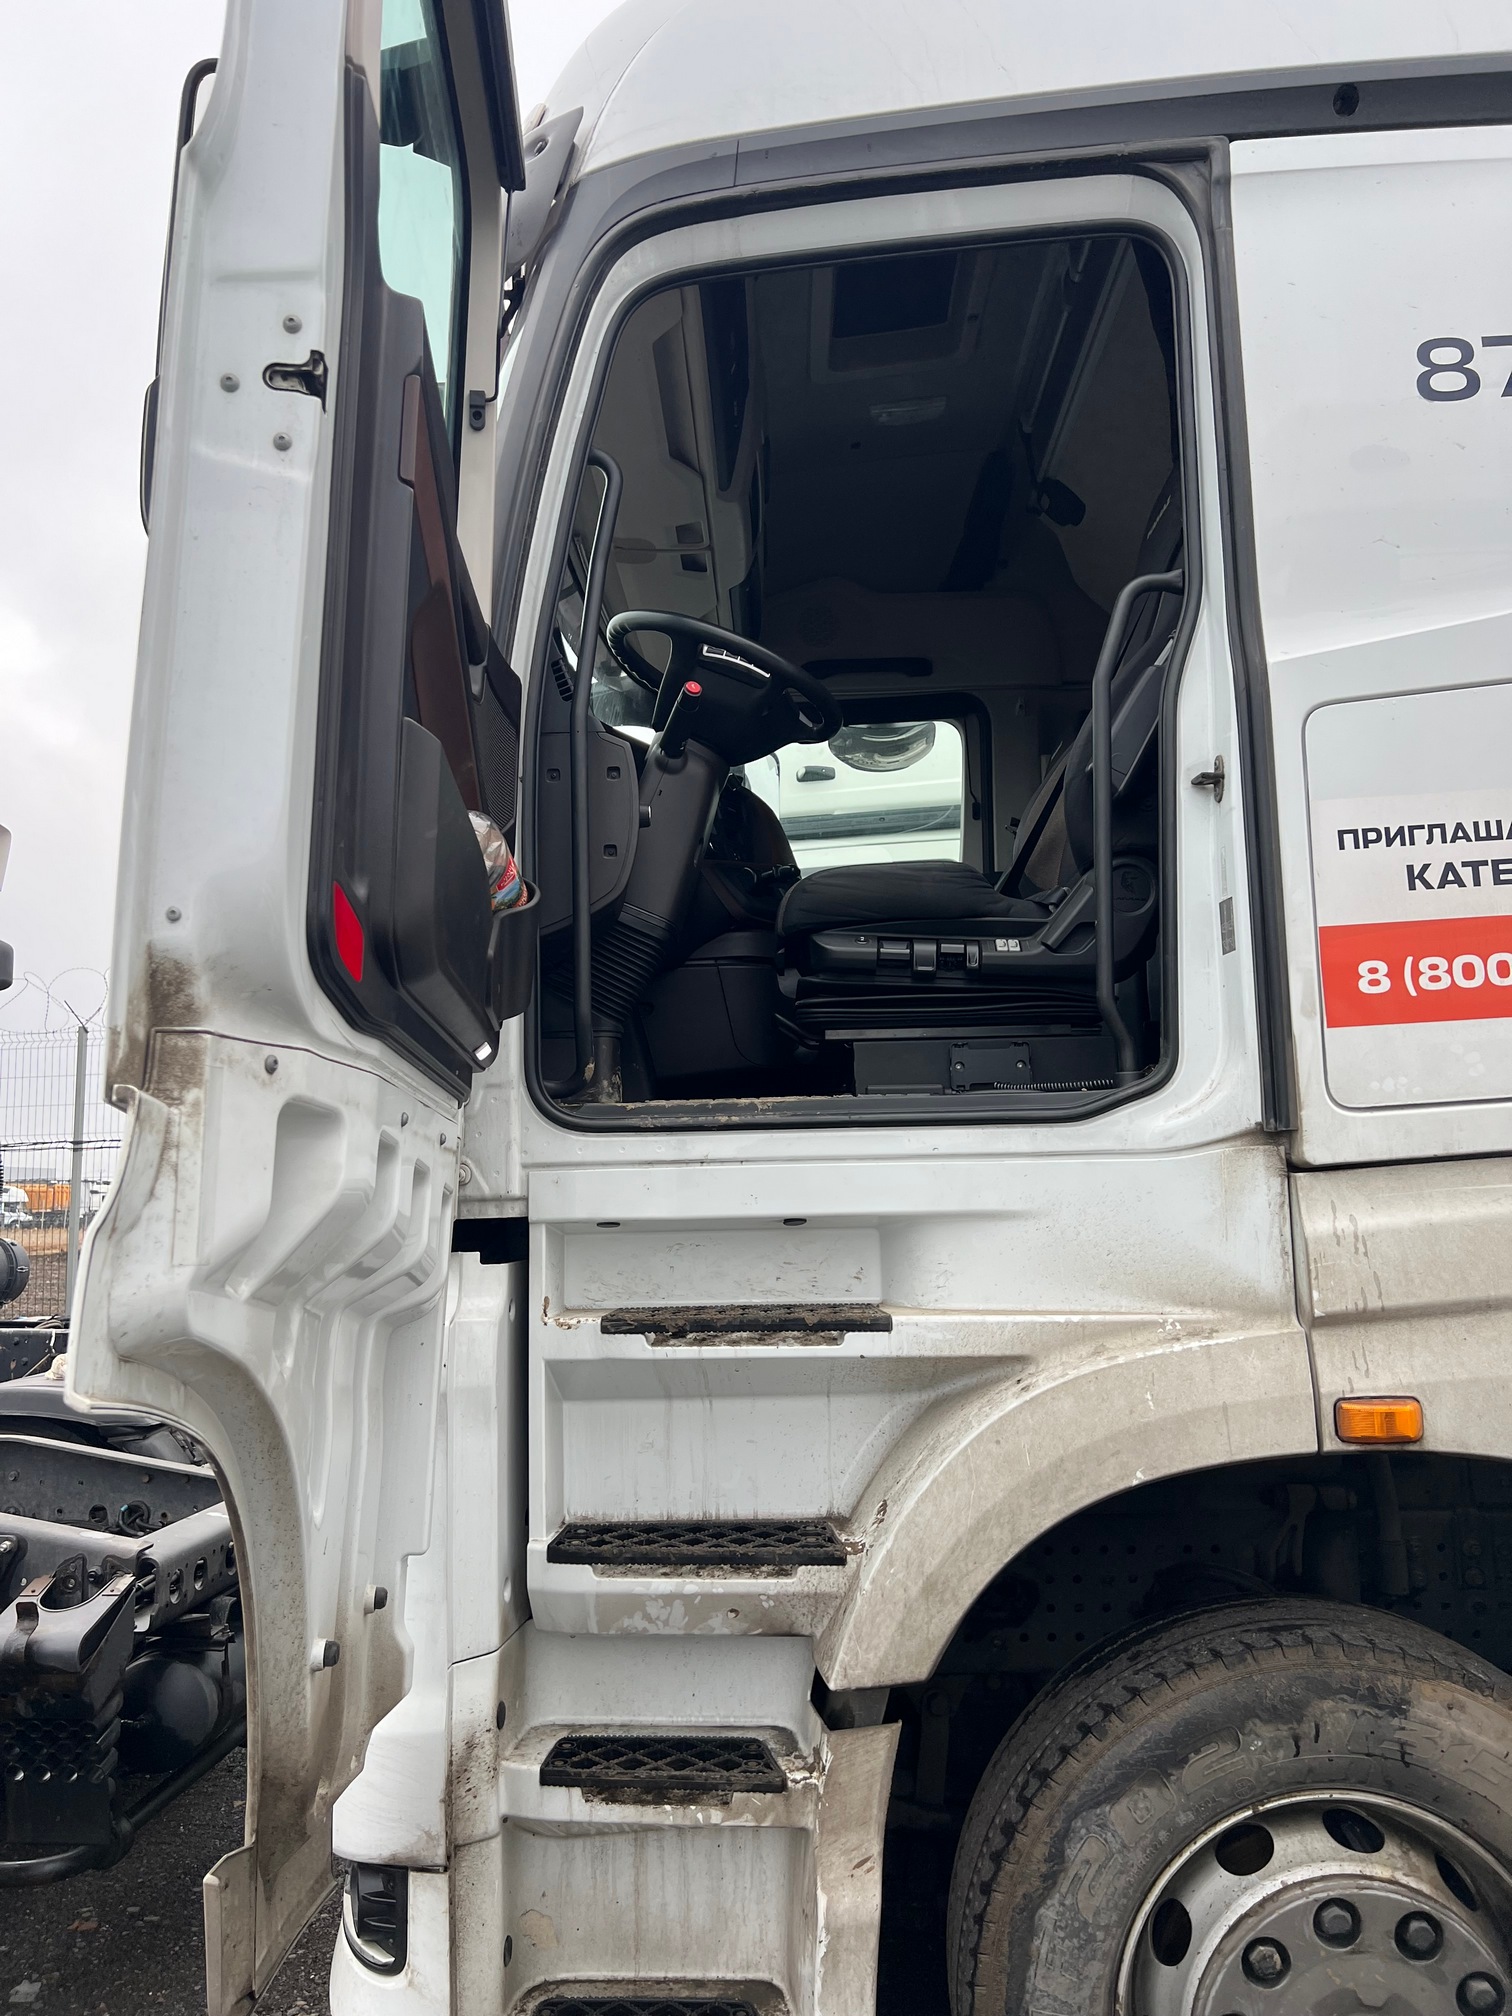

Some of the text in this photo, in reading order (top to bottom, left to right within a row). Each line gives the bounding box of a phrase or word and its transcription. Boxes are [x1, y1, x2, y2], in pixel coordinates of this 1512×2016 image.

[1337, 819, 1512, 851] ПРИГЛАШ
[1405, 858, 1512, 891] КАТЕ
[1357, 951, 1512, 997] 8 (800
